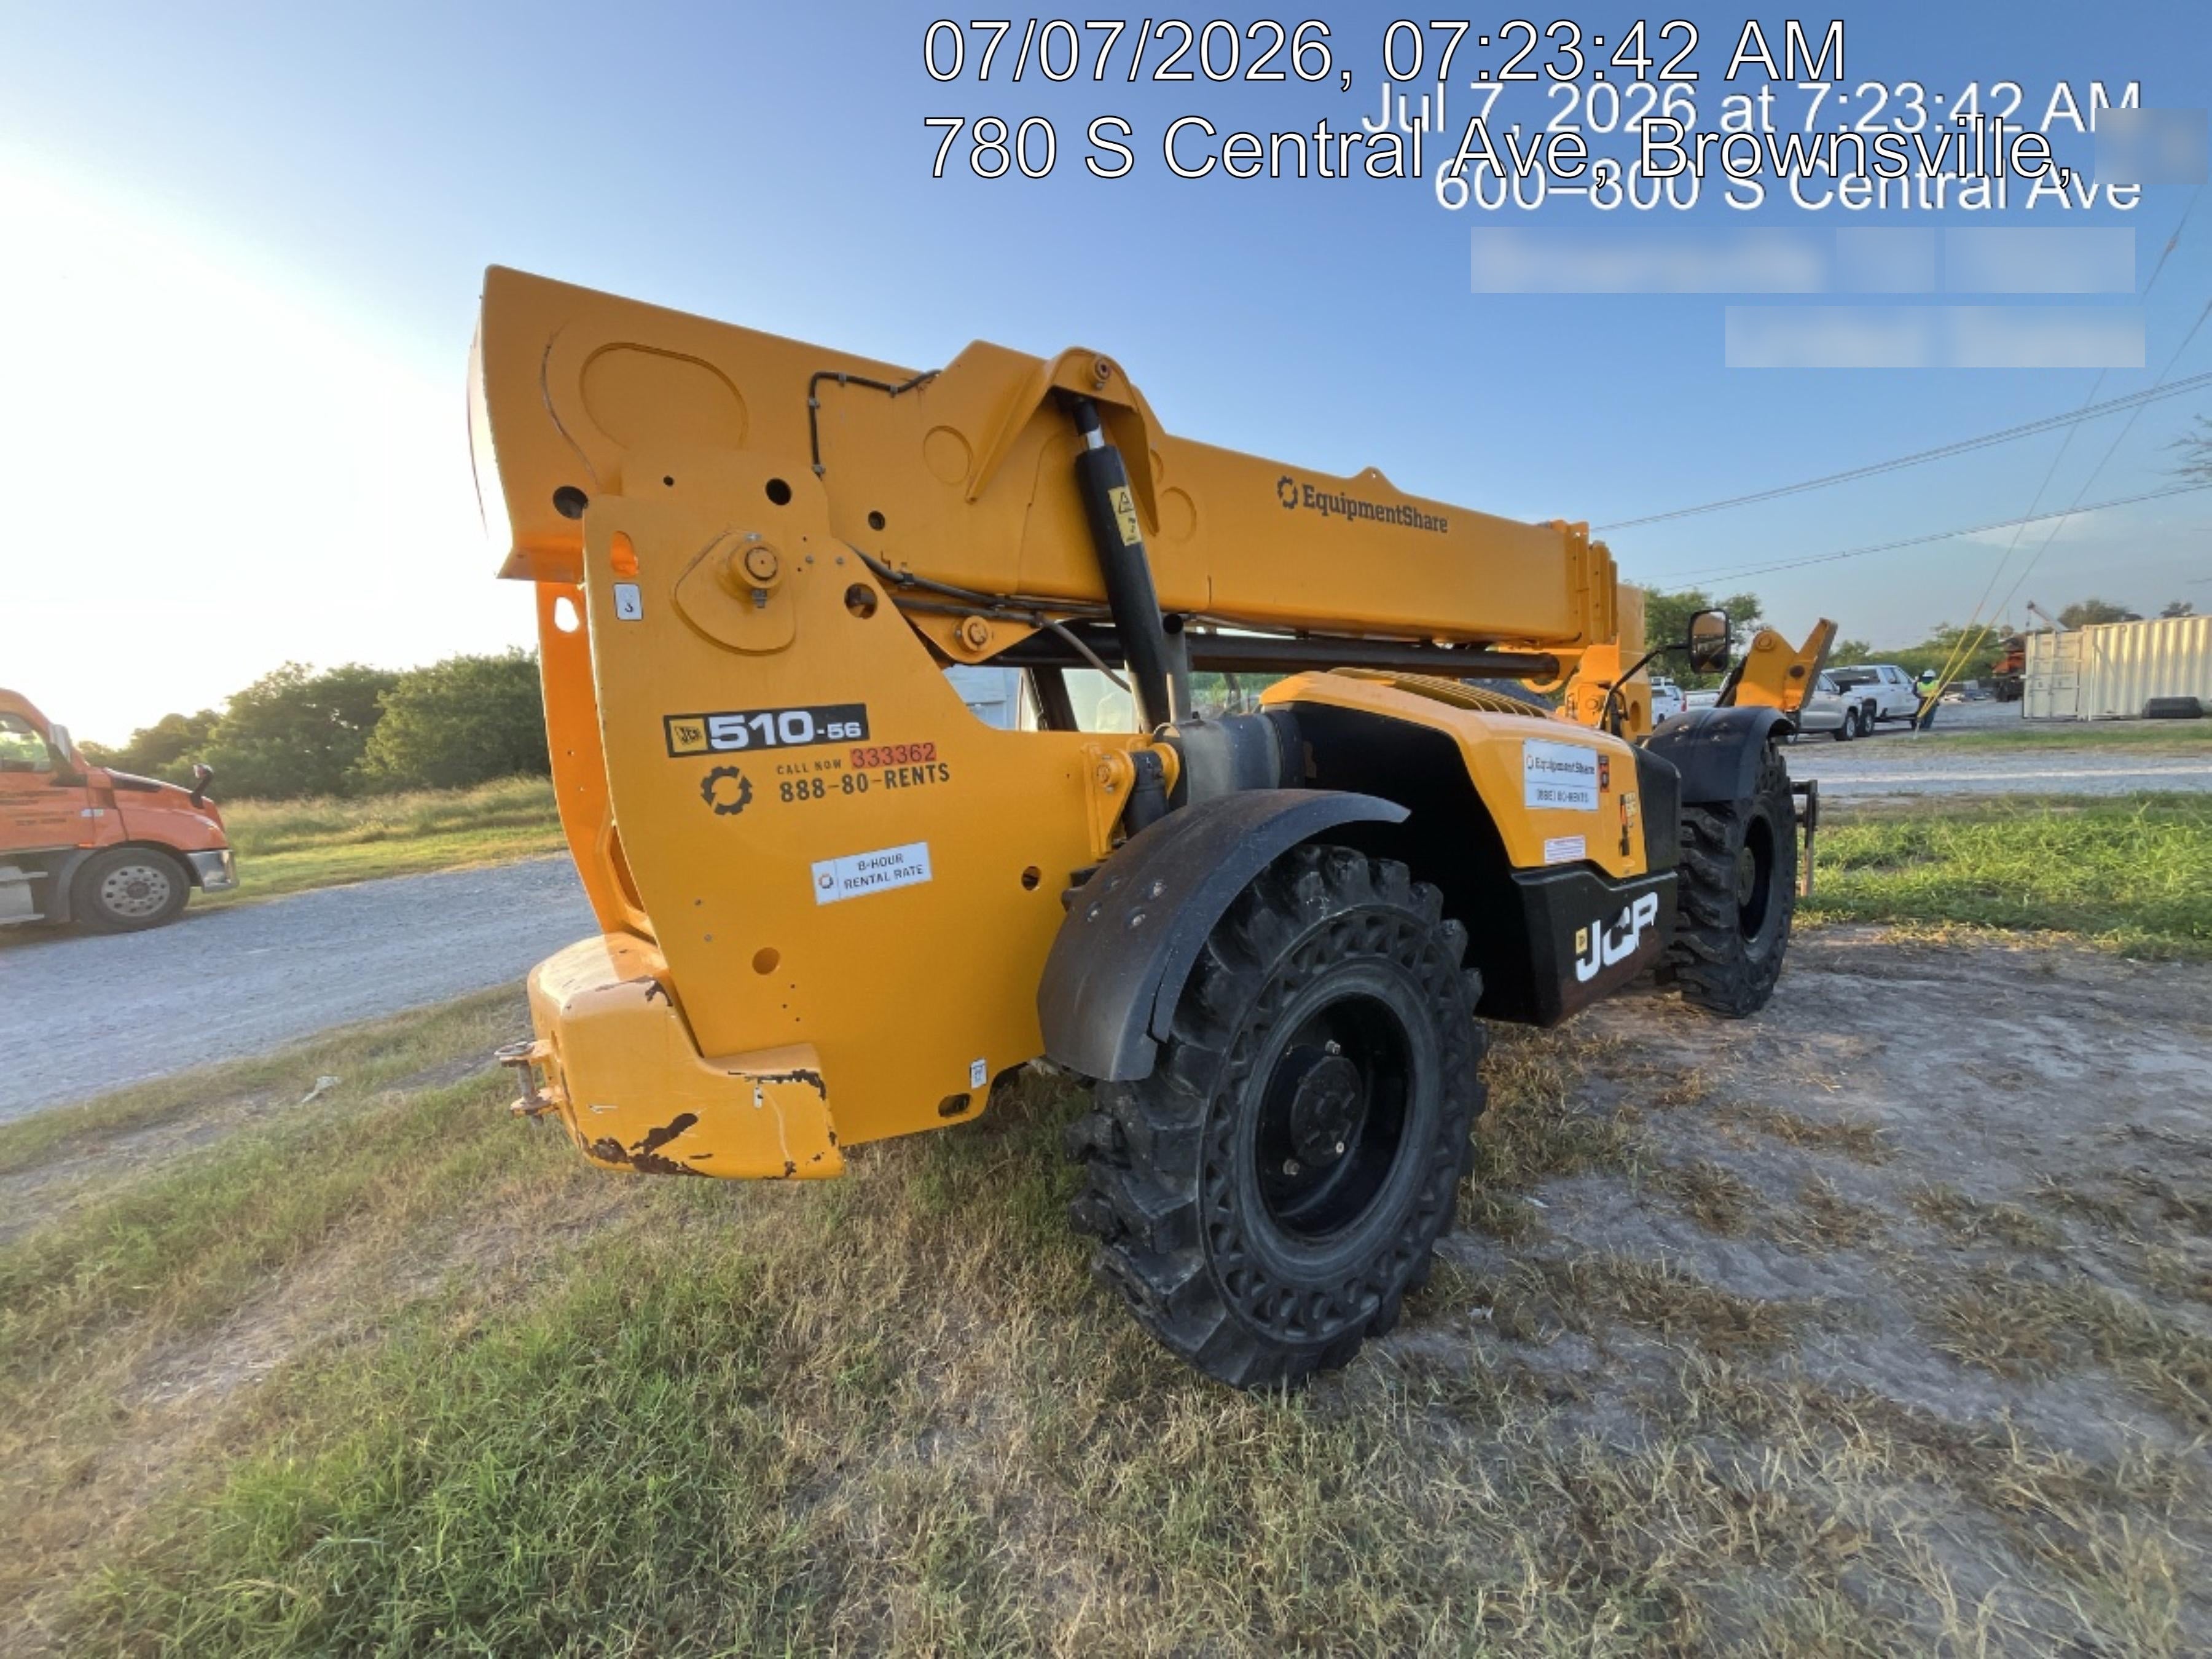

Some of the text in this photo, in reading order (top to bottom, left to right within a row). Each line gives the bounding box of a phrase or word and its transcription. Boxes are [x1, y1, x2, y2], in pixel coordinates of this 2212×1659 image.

[1302, 483, 1448, 533] EquipmentShare
[707, 711, 862, 750] 510-56
[777, 759, 841, 775] CALL NOW
[852, 742, 936, 769] 333362
[780, 763, 950, 802] 888-80-RENTS
[844, 865, 924, 890] RENTAL RATE
